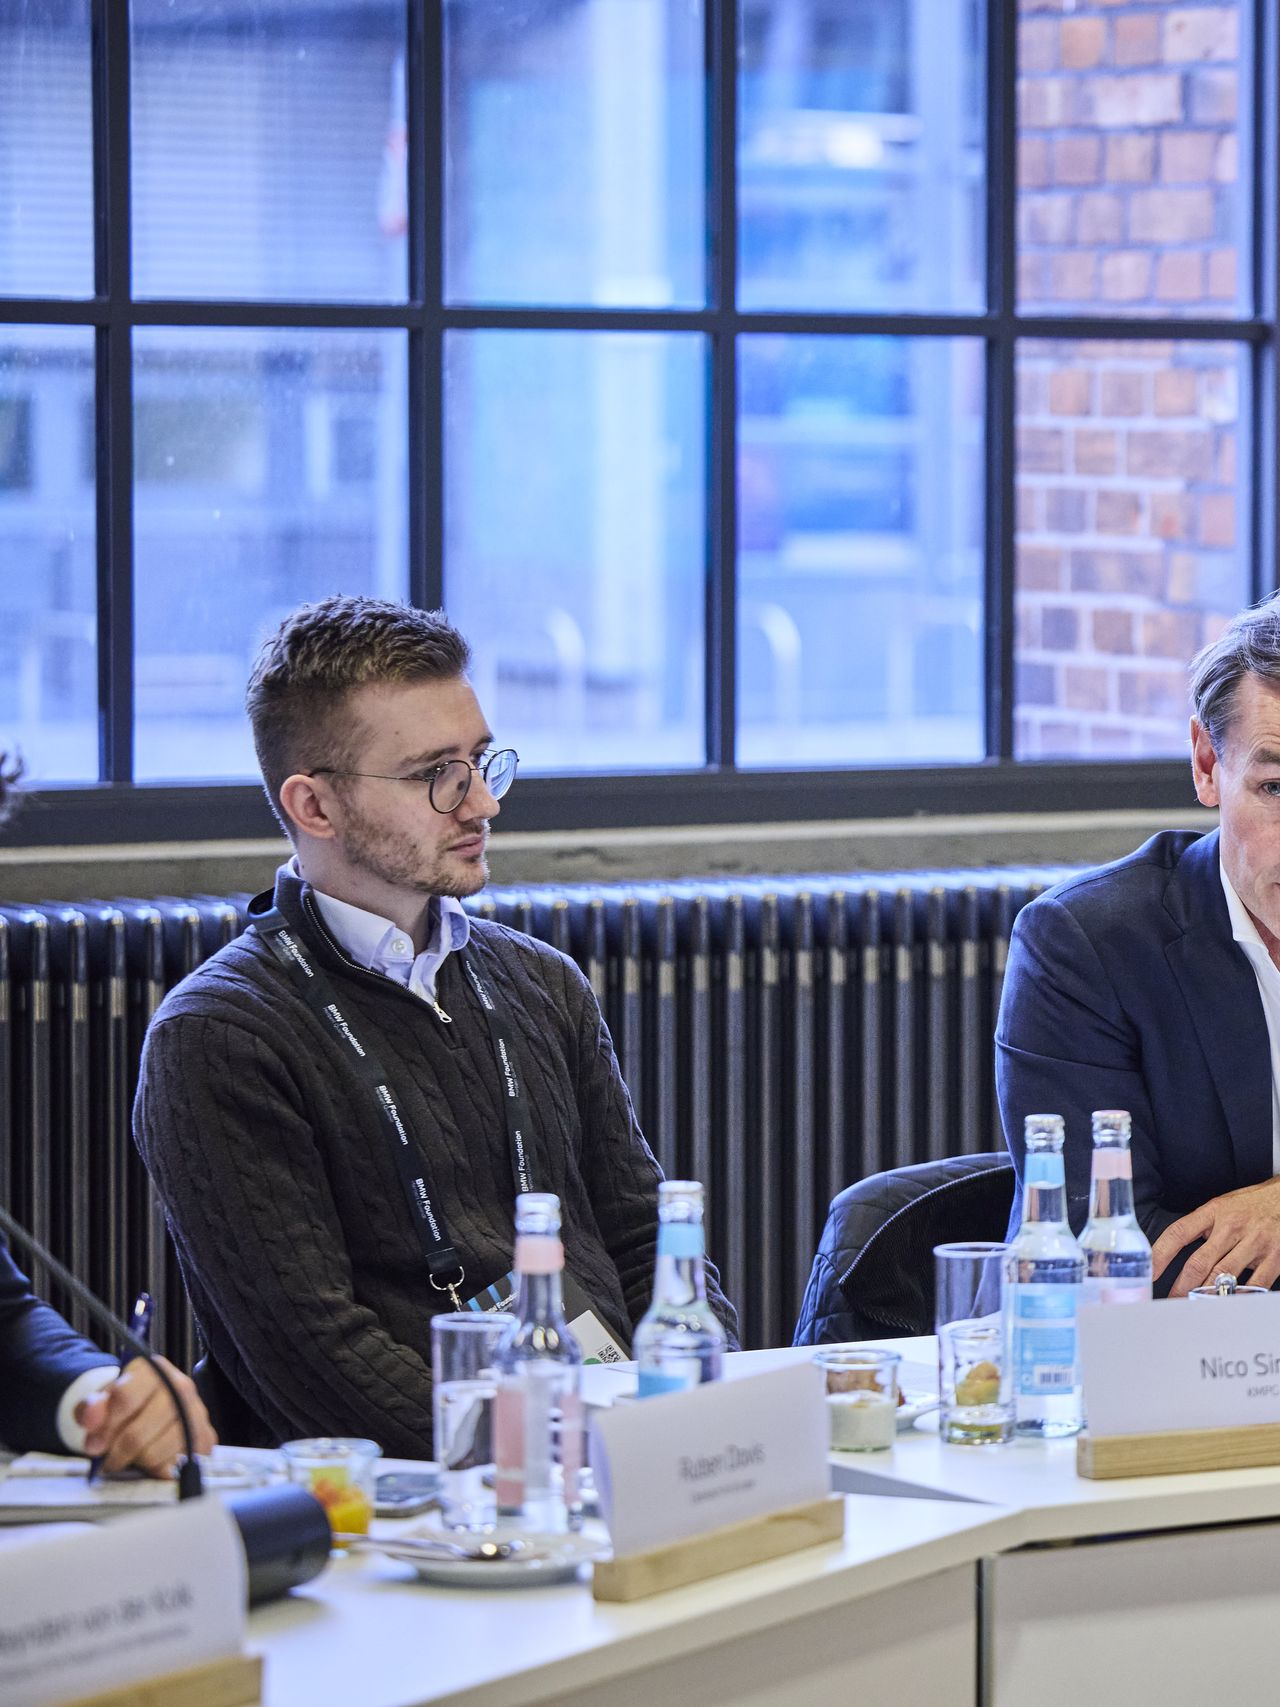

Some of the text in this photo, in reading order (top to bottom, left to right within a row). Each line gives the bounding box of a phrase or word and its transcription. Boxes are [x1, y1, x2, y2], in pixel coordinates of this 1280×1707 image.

[278, 930, 292, 946] BMW
[288, 943, 315, 978] Foundation
[327, 1004, 345, 1022] BMW
[340, 1021, 366, 1057] Foundation
[499, 1038, 512, 1076] Foundation
[504, 1077, 516, 1097] BMW
[378, 1085, 394, 1104] BMW
[389, 1104, 409, 1146] Foundation
[514, 1130, 529, 1192] BMW Foundation
[415, 1178, 428, 1199] BMW
[422, 1199, 442, 1242] Foundation
[1200, 1356, 1249, 1379] Nico
